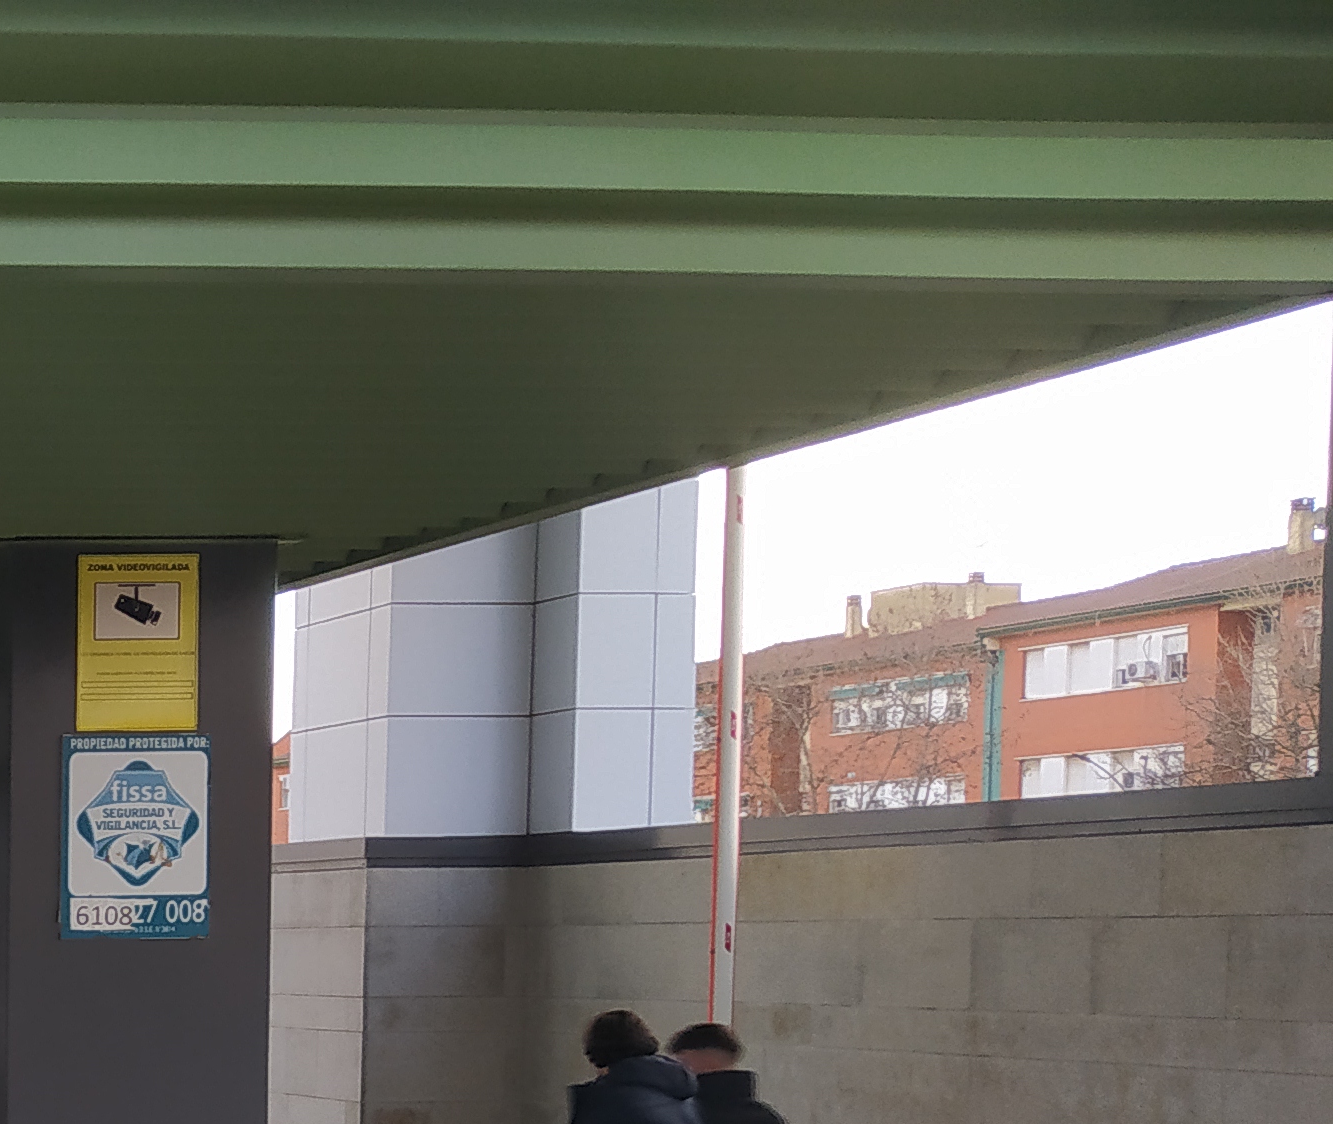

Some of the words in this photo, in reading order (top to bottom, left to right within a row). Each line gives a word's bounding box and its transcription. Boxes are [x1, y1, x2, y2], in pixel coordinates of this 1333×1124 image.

[87, 563, 115, 572] ZONA
[116, 562, 191, 572] VIDEOVIGILADA
[70, 738, 127, 750] PROPIEDAD
[128, 737, 185, 749] PROTEGIDA
[186, 736, 211, 748] POR:
[110, 780, 168, 802] fissa
[102, 807, 165, 818] SEGURIDAD
[166, 807, 175, 818] Y
[95, 820, 161, 831] VIGILANCIA,
[165, 899, 206, 924] 008
